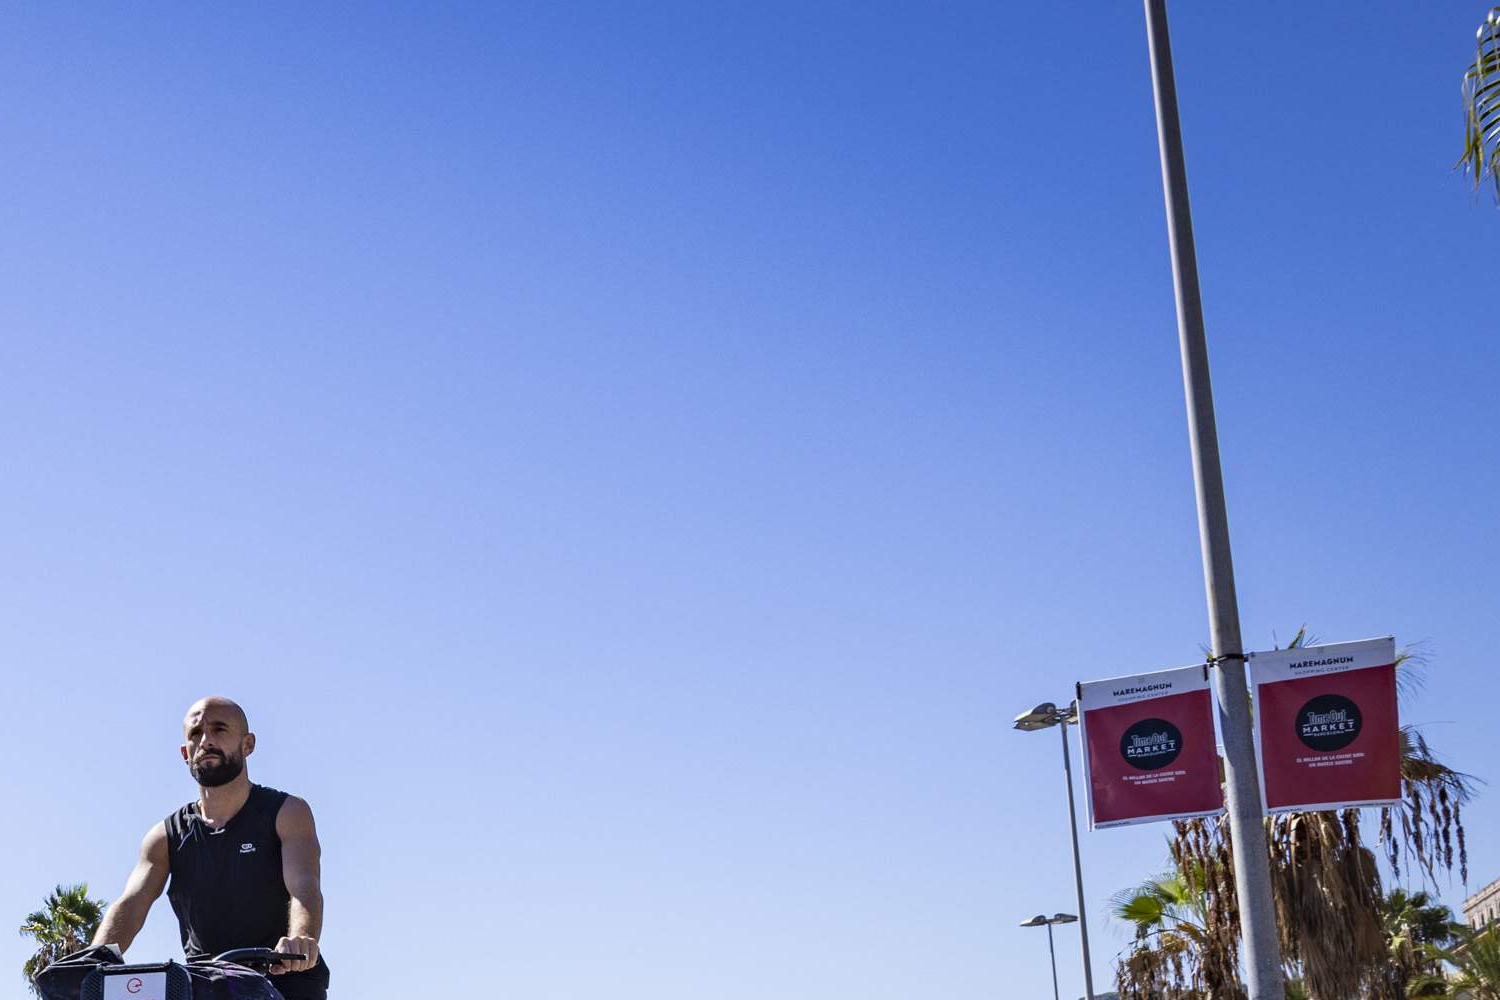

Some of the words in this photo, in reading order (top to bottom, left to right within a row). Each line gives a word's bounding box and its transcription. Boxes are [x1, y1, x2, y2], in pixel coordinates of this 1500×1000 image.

[1290, 656, 1354, 669] MAREMAGNUM
[1113, 682, 1172, 697] MAREMAGNUM
[1302, 722, 1355, 734] MARKET
[1127, 743, 1176, 755] MARKET
